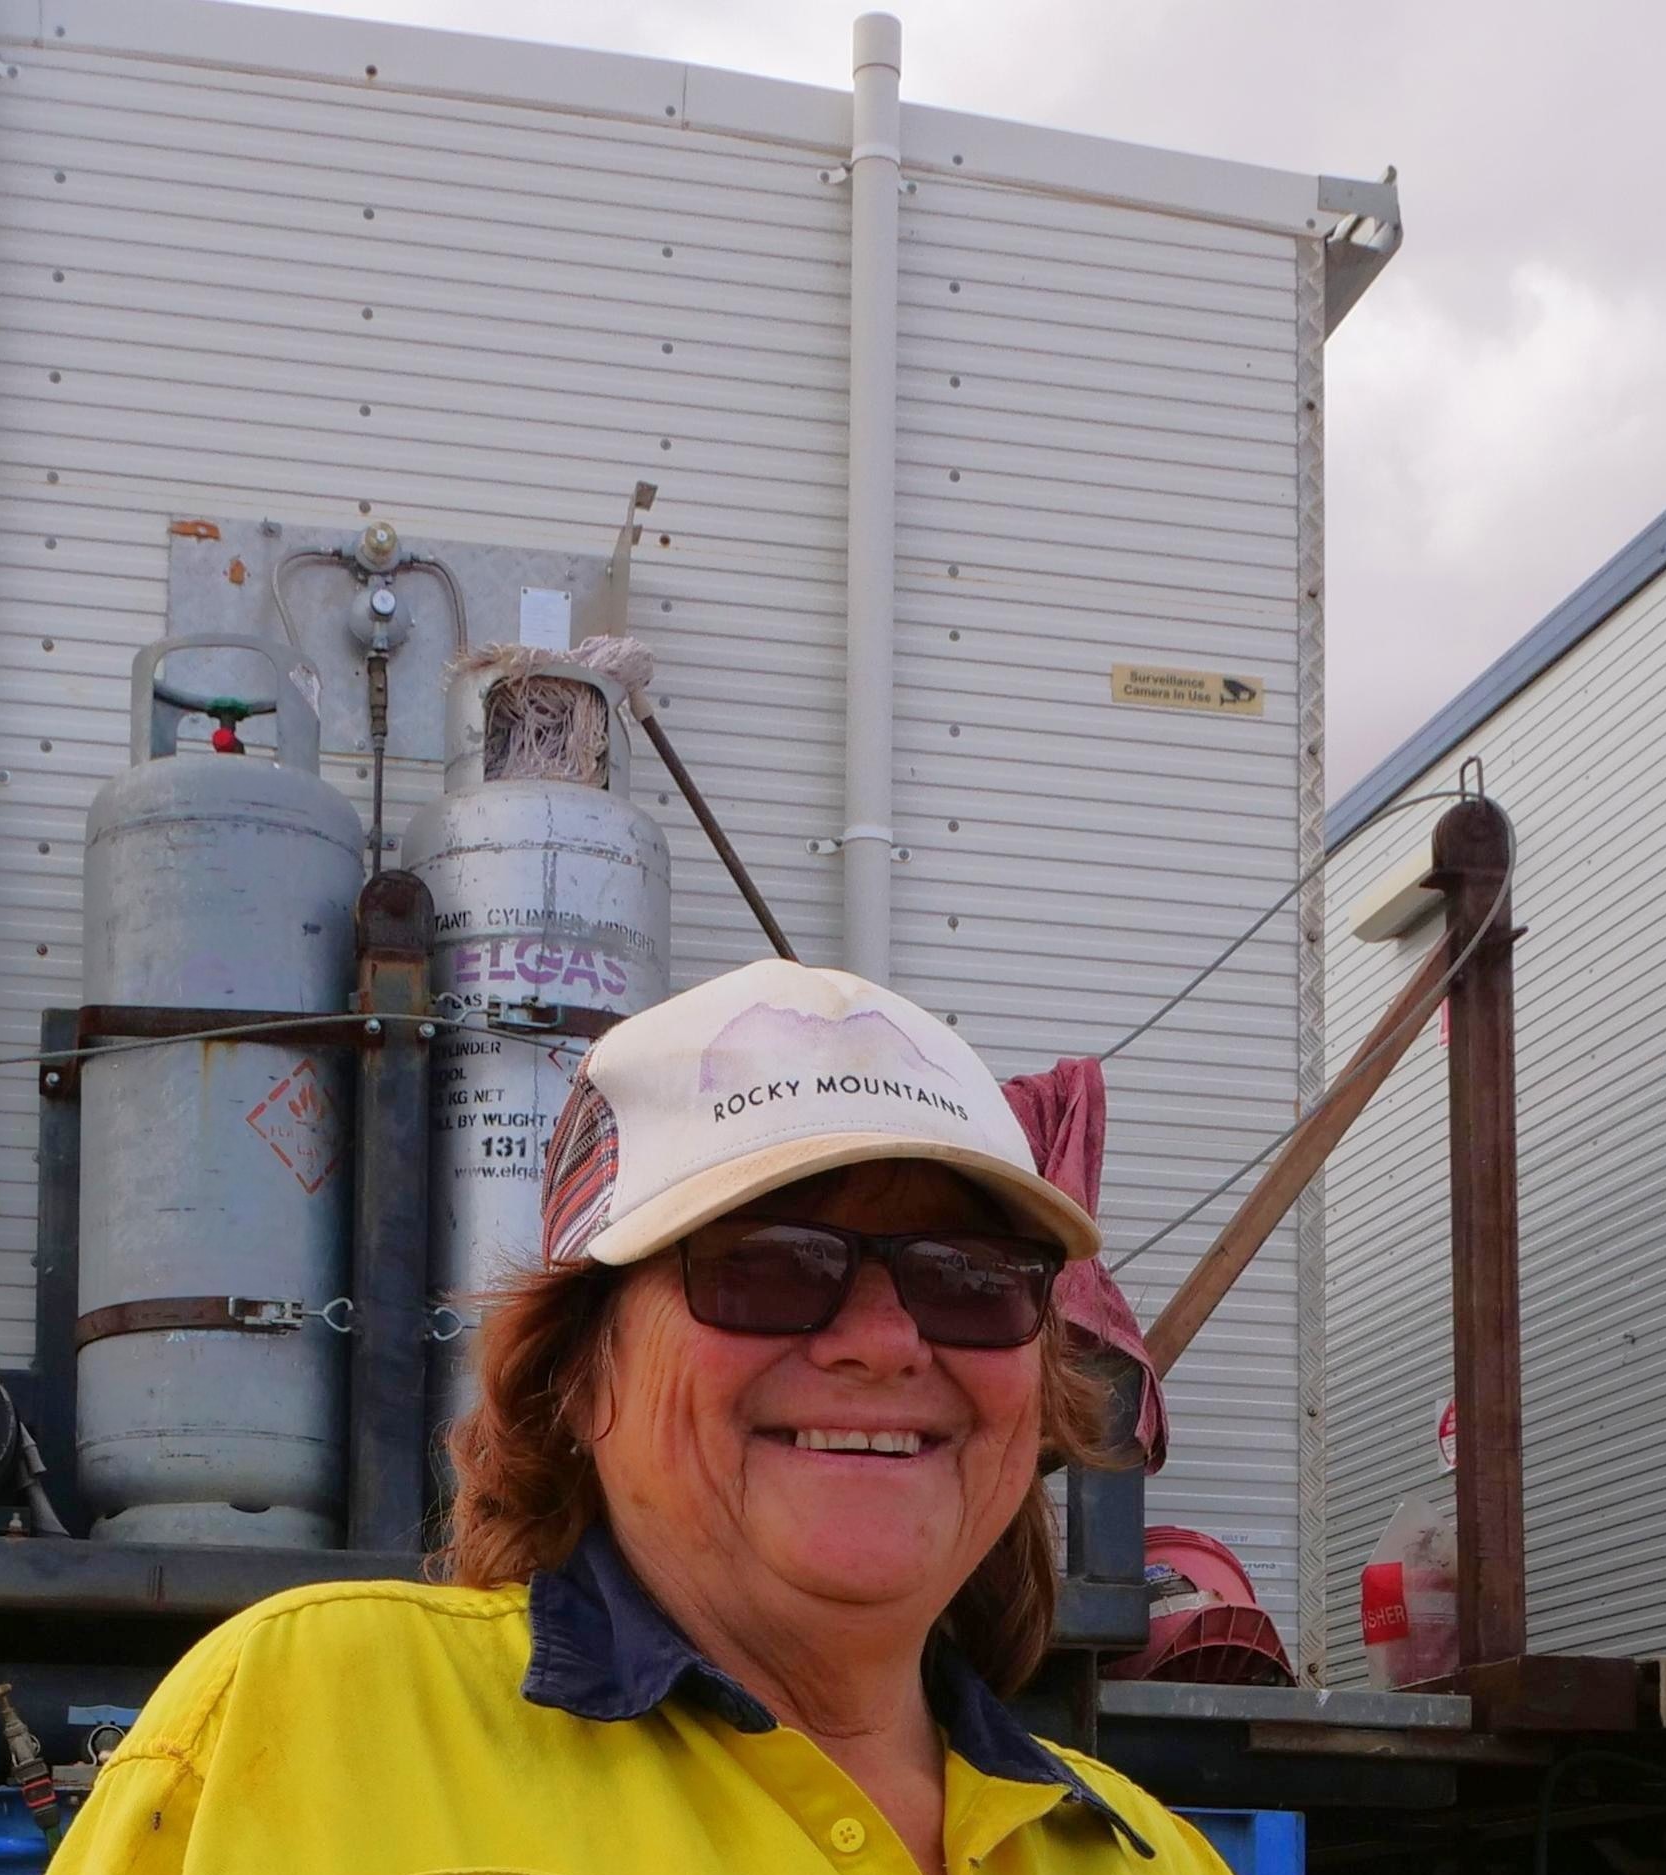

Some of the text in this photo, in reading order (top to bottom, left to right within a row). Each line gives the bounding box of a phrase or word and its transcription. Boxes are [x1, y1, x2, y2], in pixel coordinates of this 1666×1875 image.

[1130, 670, 1205, 689] Surveillance
[1124, 683, 1211, 703] Camera In Use
[455, 935, 628, 996] ELGAS
[448, 1090, 468, 1105] KG
[714, 1075, 968, 1122] ROCKY MOUNTAINS
[458, 1114, 477, 1129] BY
[481, 1136, 527, 1159] 131
